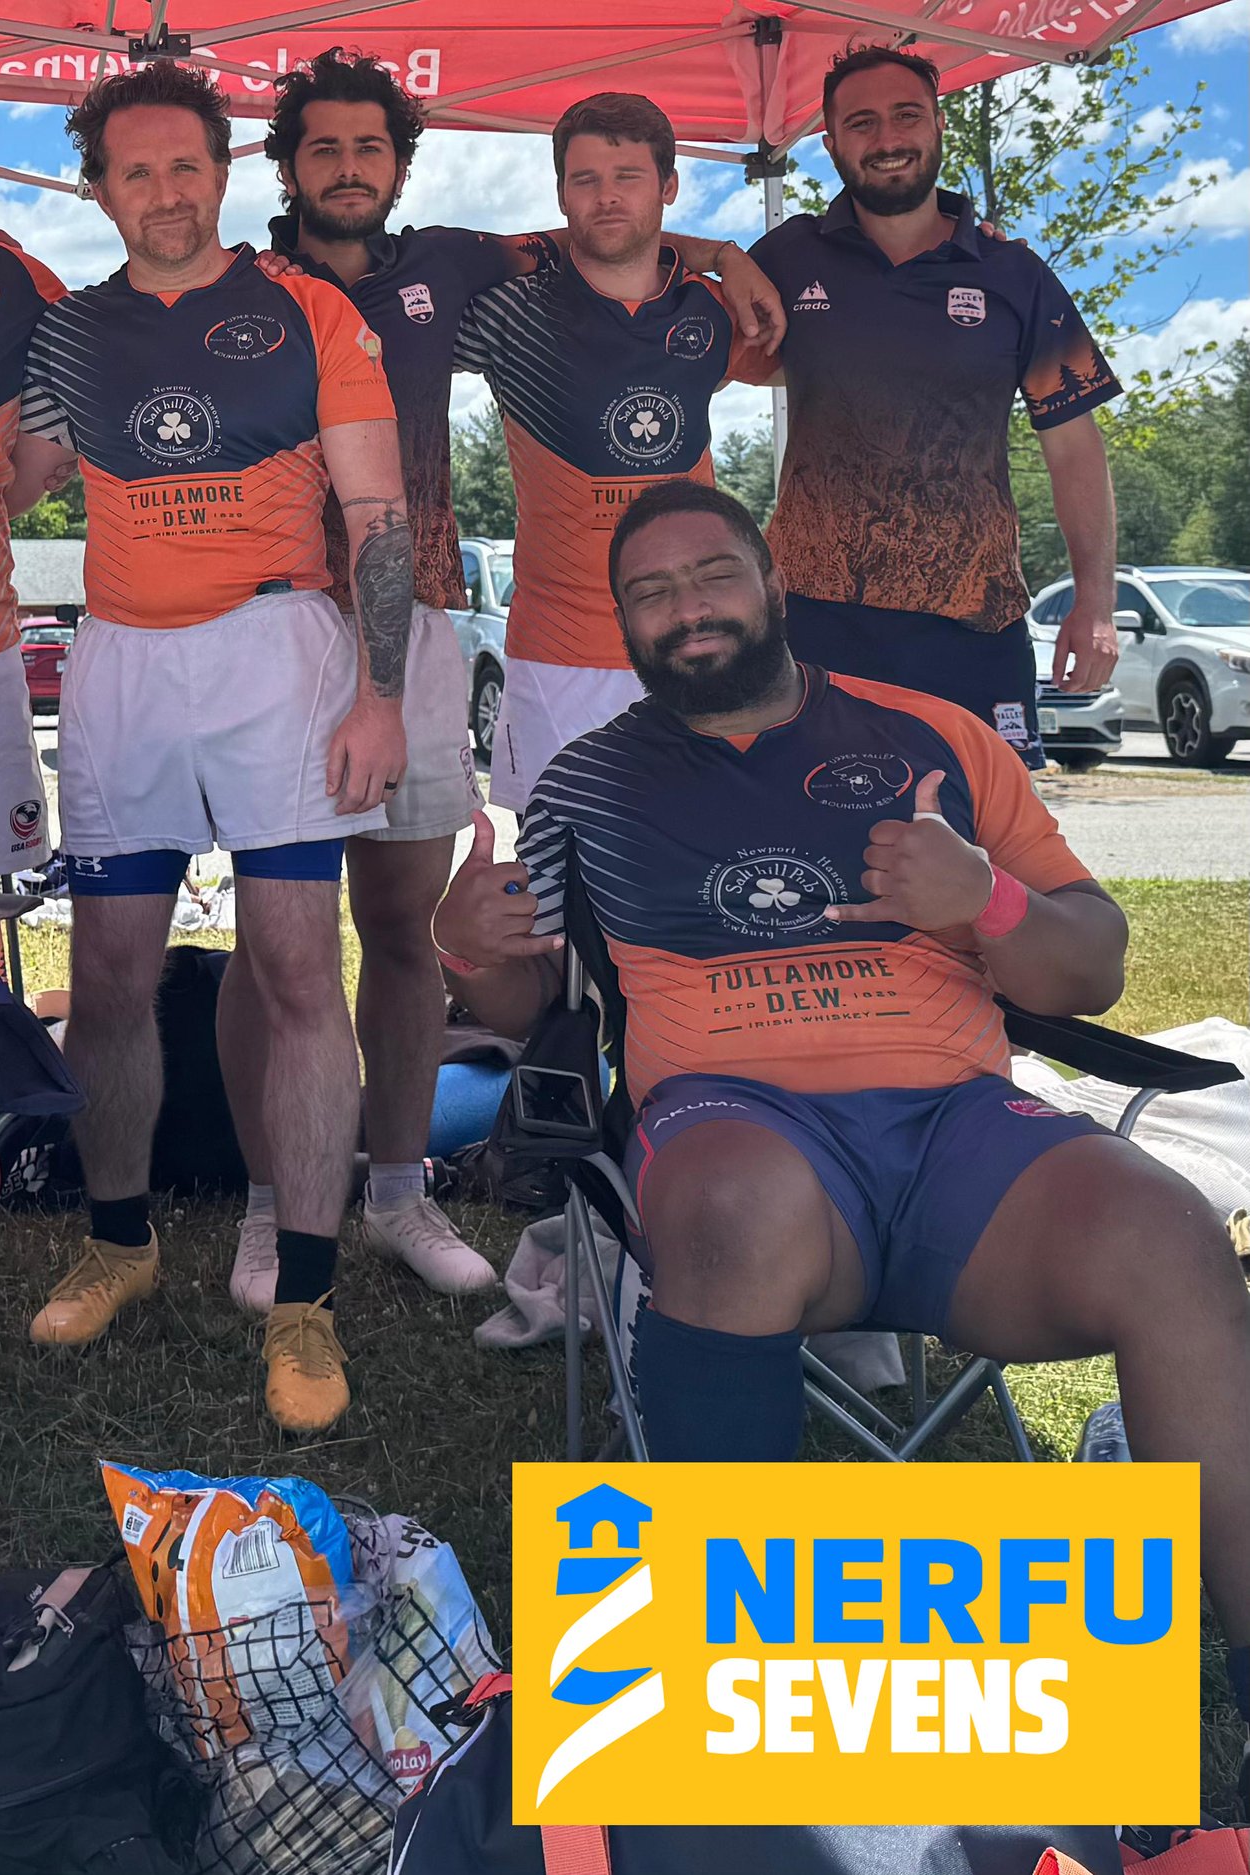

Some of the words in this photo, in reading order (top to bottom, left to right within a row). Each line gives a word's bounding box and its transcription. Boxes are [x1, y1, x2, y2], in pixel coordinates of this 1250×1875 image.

[793, 301, 831, 311] credo
[950, 293, 984, 303] VALLEY
[152, 385, 191, 394] Newport
[142, 406, 162, 426] Salt
[162, 398, 184, 410] hill
[183, 401, 202, 422] Pub
[617, 404, 636, 423] Salt
[637, 398, 656, 409] hill
[656, 401, 672, 421] Pub
[127, 485, 244, 510] TULLAMORE
[11, 842, 25, 853] USA
[736, 847, 796, 859] Newport
[725, 869, 754, 894] Salt
[754, 863, 787, 876] hill
[788, 867, 819, 893] Pub
[705, 957, 895, 994] TULLAMORE
[765, 987, 847, 1014] D.E.W.
[748, 1018, 794, 1029] IRISH
[801, 1011, 871, 1023] WHISKEY
